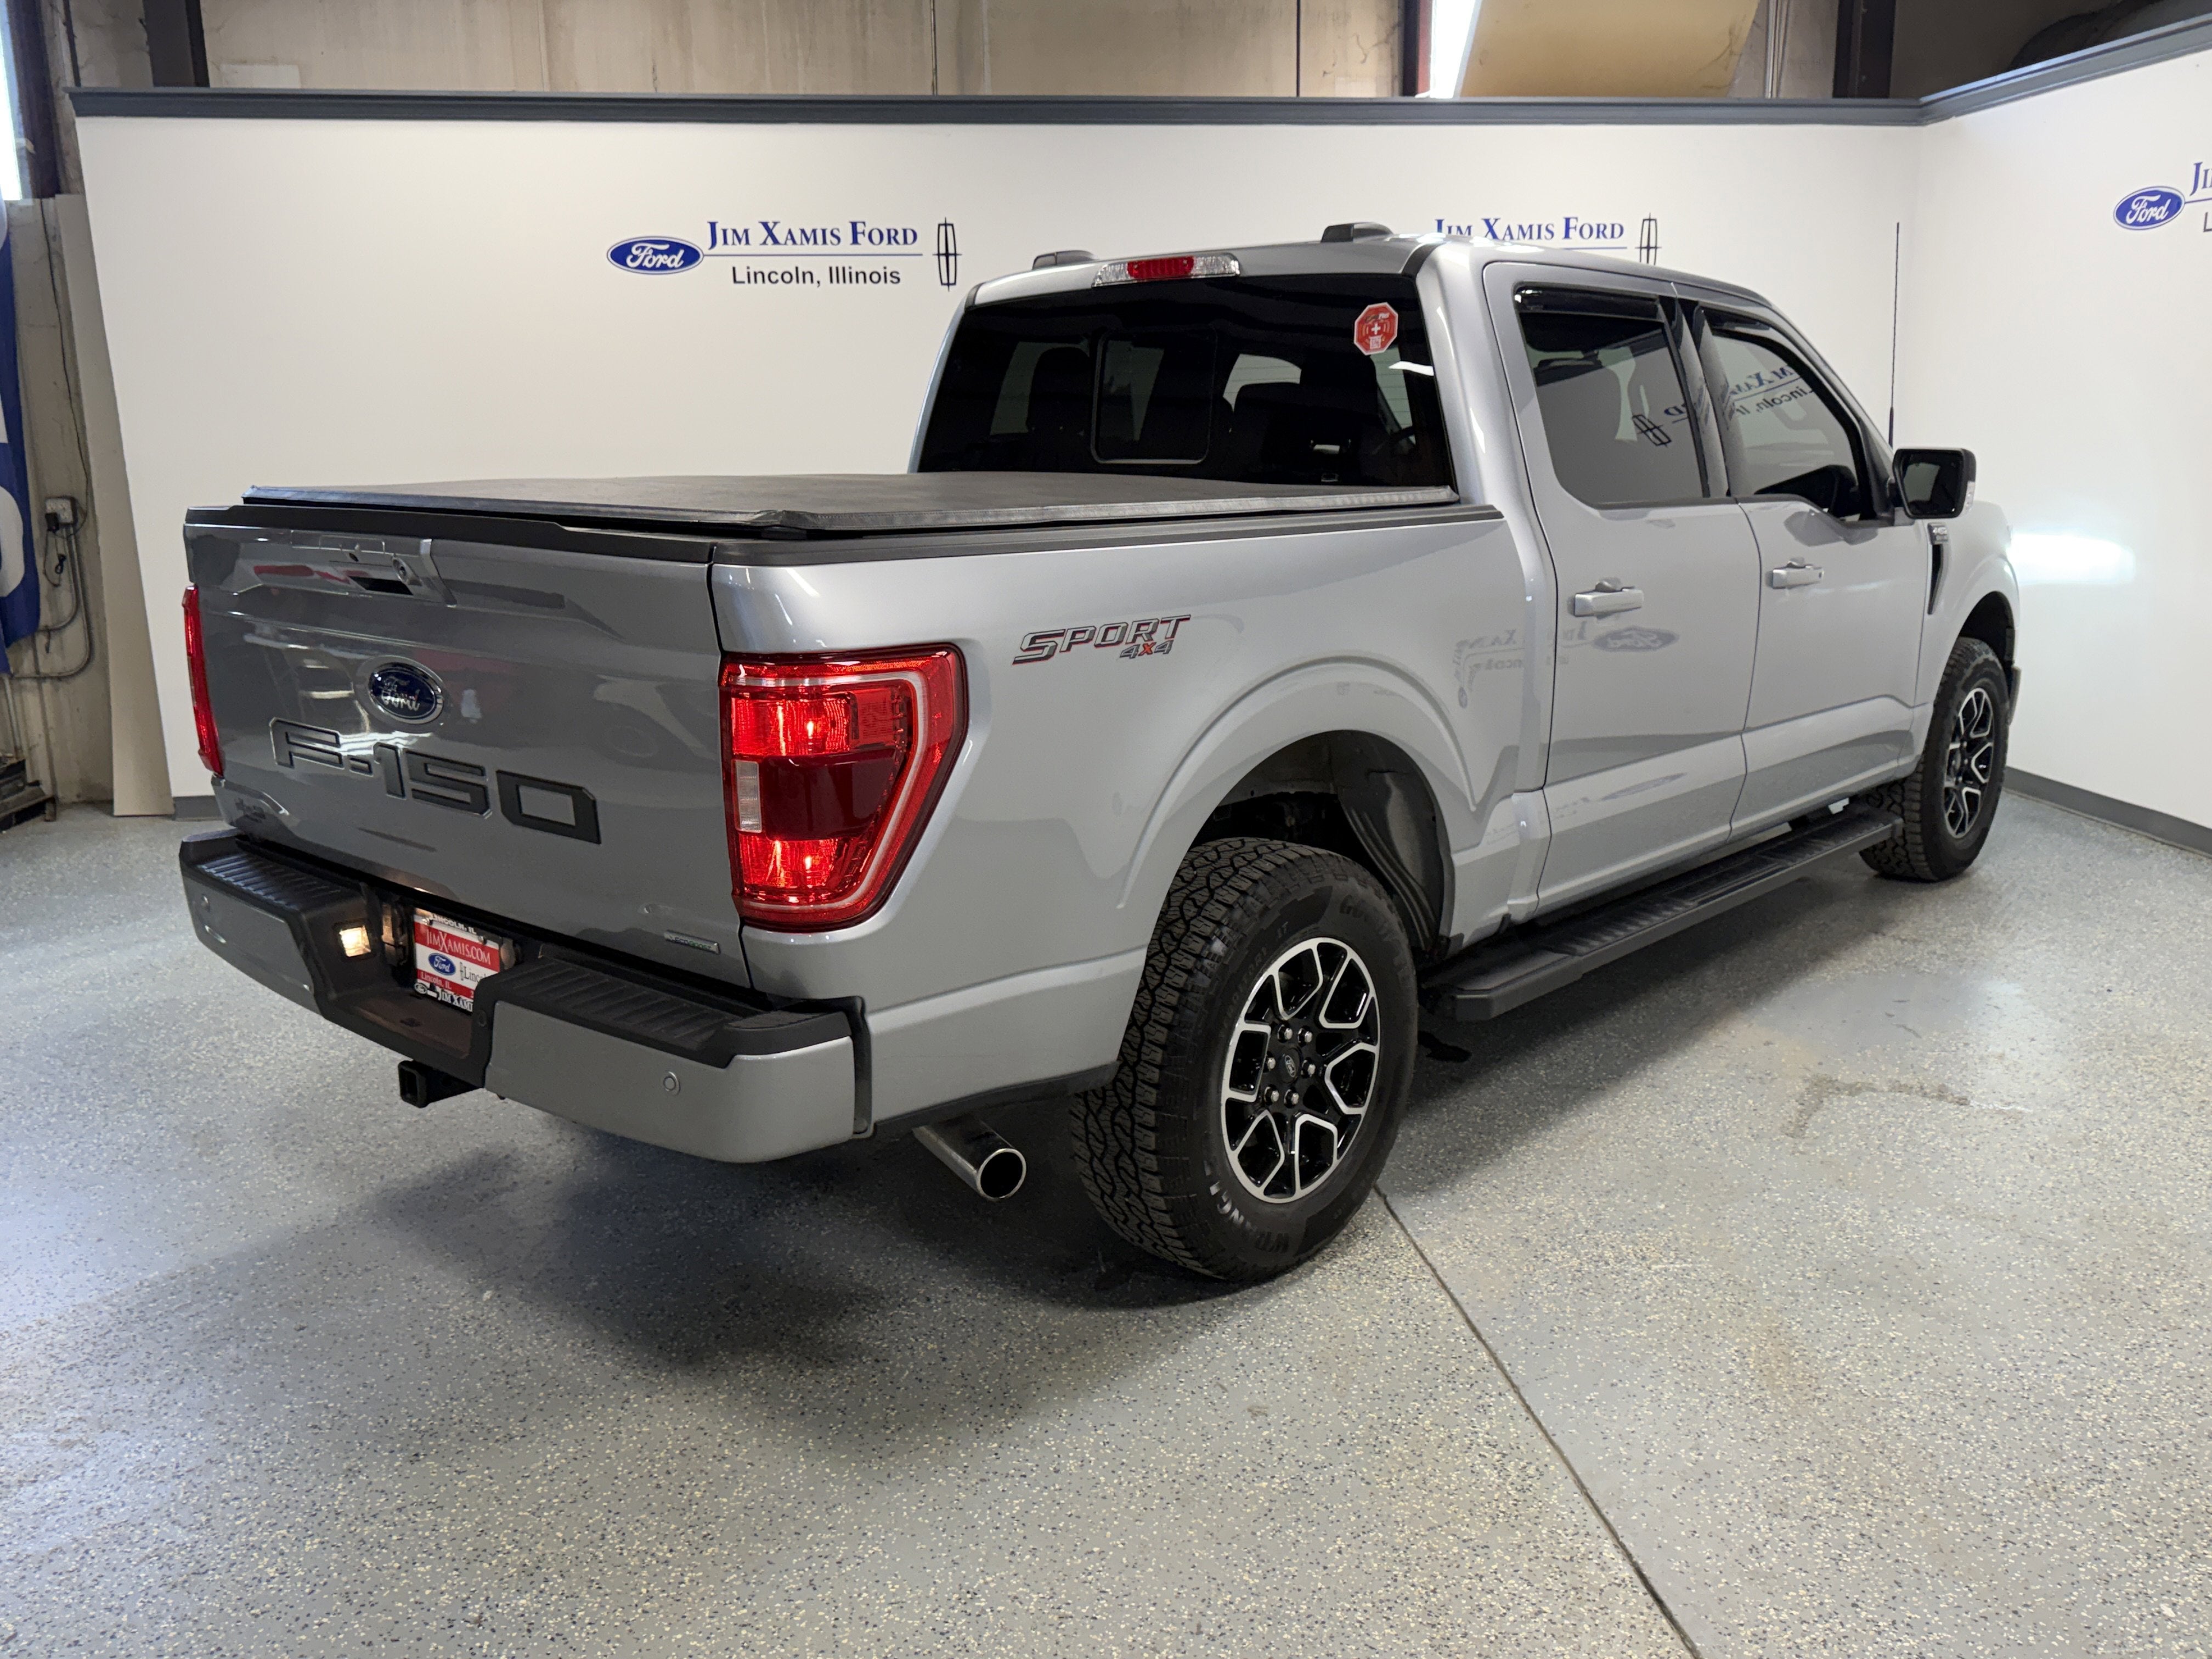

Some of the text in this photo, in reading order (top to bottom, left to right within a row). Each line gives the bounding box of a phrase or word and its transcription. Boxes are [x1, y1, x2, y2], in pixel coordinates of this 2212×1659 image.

[2190, 161, 2212, 196] JI
[2126, 194, 2171, 224] Ford
[708, 222, 918, 250] JIM XAMIS FORD
[1482, 218, 1555, 241] XAMIS
[1562, 217, 1624, 240] FORD
[626, 242, 685, 268] Ford
[732, 266, 901, 287] Lincoln, Illinois
[1012, 614, 1191, 665] SPORT
[269, 717, 601, 845] F-150
[434, 956, 450, 972] Ford
[464, 966, 487, 983] Linc
[452, 994, 473, 1013] XAMI
